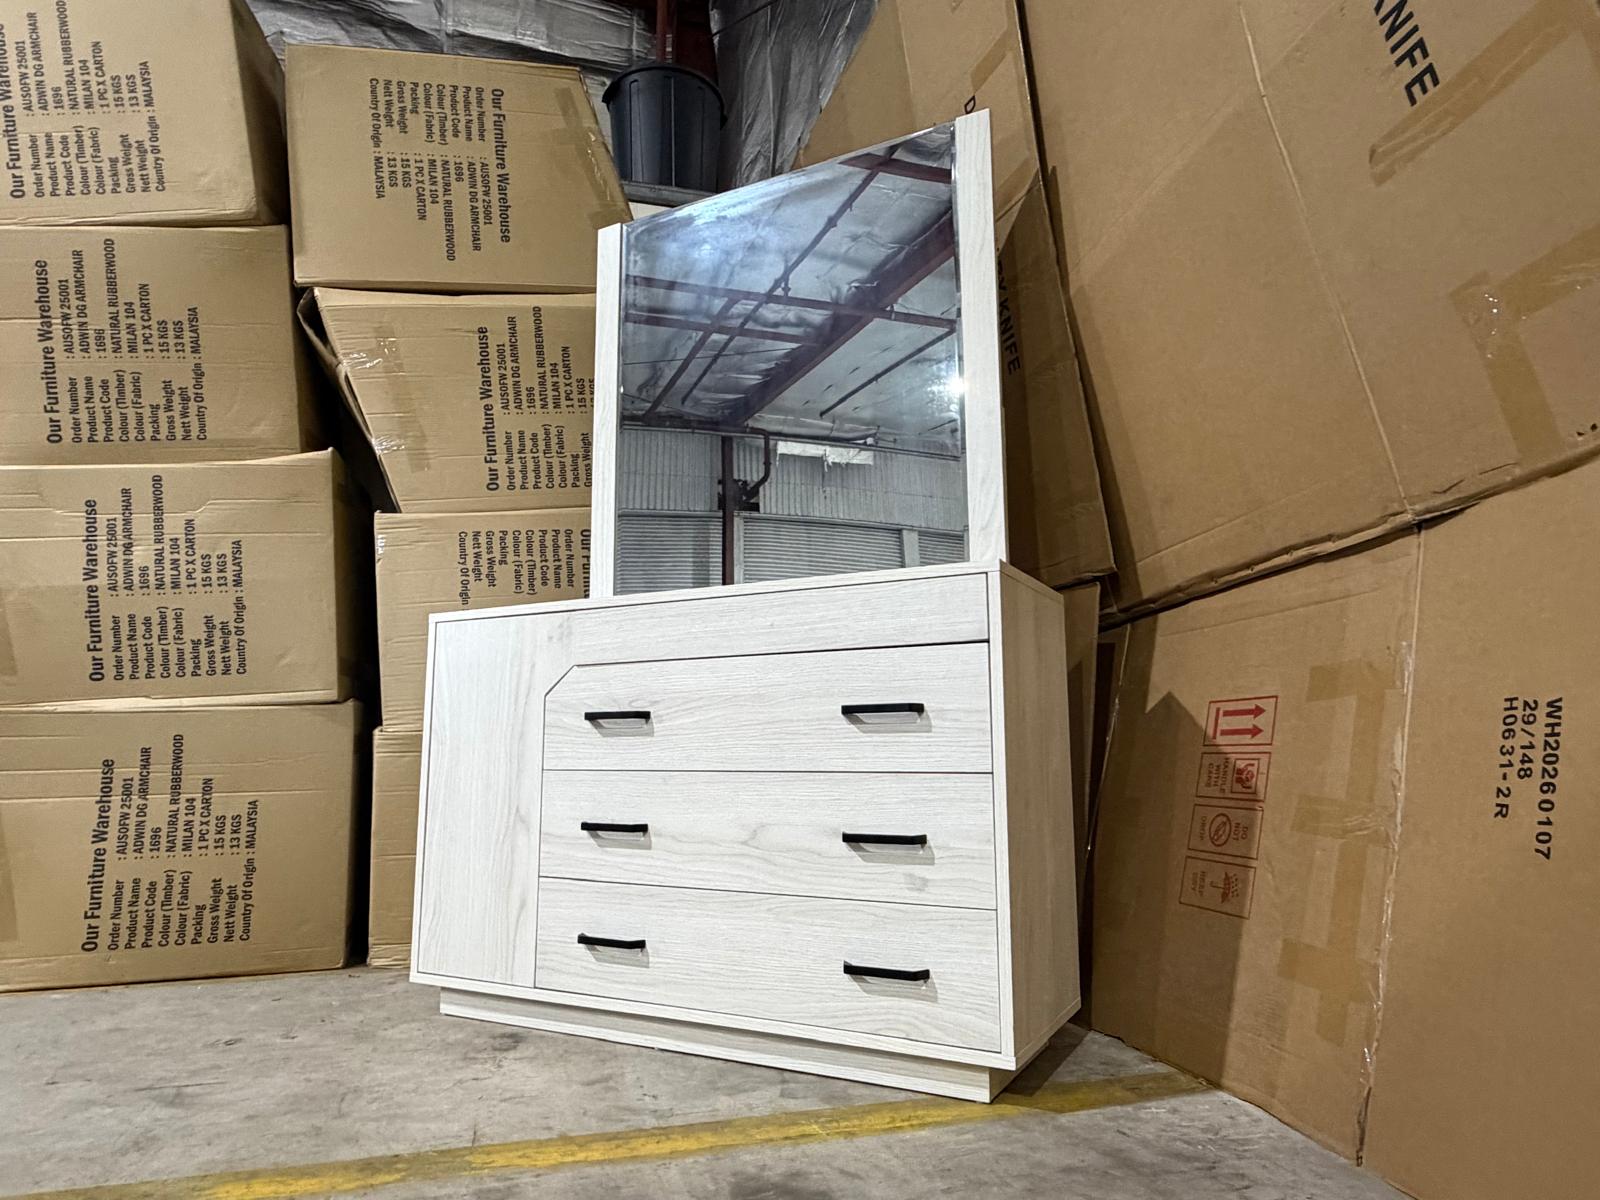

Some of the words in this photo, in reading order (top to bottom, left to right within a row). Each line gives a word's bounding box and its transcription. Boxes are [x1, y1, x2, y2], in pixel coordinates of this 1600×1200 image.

[1374, 0, 1440, 107] NIFE
[491, 89, 504, 111] Our
[2, 105, 22, 170] Furniture
[493, 113, 507, 170] Furniture
[10, 174, 26, 199] Our
[497, 173, 512, 243] Warehouse
[104, 239, 119, 308] RUBBERWOOD
[34, 260, 54, 342] Warehouse
[58, 279, 71, 310] 25001
[60, 312, 74, 354] AUSOFW
[108, 309, 122, 353] NATURAL
[157, 320, 168, 339] KGS
[187, 307, 201, 354] MALAYSIA
[507, 316, 520, 364] ARMCHAIR
[532, 306, 546, 368] RUBBERWOOD
[999, 297, 1021, 375] KNIFE
[159, 341, 170, 353] 15
[477, 327, 493, 400] Warehouse
[496, 343, 507, 371] 25001
[561, 346, 572, 380] CARTON
[40, 346, 60, 413] Furniture
[192, 363, 205, 390] Origin
[511, 366, 521, 378] DG
[67, 377, 80, 415] Number
[113, 369, 129, 410] (Timber)
[161, 380, 175, 413] Weight
[193, 392, 204, 403] Of
[498, 373, 510, 410] AUSOFW
[512, 380, 523, 410] ADWIN
[537, 370, 549, 409] NATURAL
[564, 389, 574, 401] PC
[46, 418, 63, 444] Our
[71, 417, 83, 443] Order
[118, 411, 130, 442] Colour
[165, 415, 177, 441] Gross
[195, 405, 208, 441] Country
[482, 404, 498, 464] Furniture
[503, 431, 514, 464] Number
[517, 430, 527, 454] Name
[541, 424, 554, 459] (Timber)
[486, 467, 499, 491] Our
[506, 466, 516, 491] Order
[518, 456, 529, 490] Product
[545, 460, 555, 489] Colour
[570, 453, 581, 488] Packing
[121, 488, 133, 540] ARMCHAIR
[82, 499, 99, 581] Warehouse
[106, 517, 118, 548] 25001
[122, 542, 134, 556] DG
[169, 537, 180, 555] 104
[184, 519, 196, 557] CARTON
[457, 531, 469, 565] Country
[472, 531, 482, 550] Nett
[485, 530, 495, 555] Gross
[498, 530, 509, 566] Packing
[512, 530, 522, 558] Colour
[525, 530, 535, 557] Colour
[538, 529, 549, 563] Product
[551, 529, 562, 563] Product
[564, 529, 574, 552] Order
[107, 550, 119, 592] AUSOFW
[123, 558, 134, 591] ADWIN
[170, 558, 181, 590] MILAN
[185, 568, 197, 580] PC
[460, 567, 470, 577] Of
[471, 551, 483, 582] Weight
[485, 556, 497, 587] Weight
[512, 560, 524, 594] (Fabric)
[525, 559, 538, 595] (Timber)
[540, 565, 550, 587] Code
[553, 564, 562, 589] Name
[566, 554, 575, 588] Number
[459, 579, 471, 605] Origin
[84, 585, 103, 652] Furniture
[110, 615, 122, 653] Number
[126, 614, 137, 641] Name
[172, 608, 187, 645] (Fabric)
[89, 656, 105, 682] Our
[112, 655, 125, 681] Order
[127, 643, 140, 680] Product
[175, 647, 186, 678] Colour
[189, 639, 202, 677] Packing
[1517, 699, 1539, 780] 29/148
[169, 734, 184, 805] RUBBERWOOD
[1493, 697, 1519, 819] H0631-2R
[1534, 697, 1563, 861] WH20260107
[91, 759, 115, 844] Warehouse
[184, 797, 196, 817] 104
[149, 827, 162, 852] 1696
[165, 807, 180, 852] NATURAL
[181, 820, 194, 852] MILAN
[214, 815, 226, 835] KGS
[213, 837, 225, 849] 15
[84, 848, 107, 920] Furniture
[144, 881, 157, 907] Code
[160, 869, 177, 912] (Timber)
[177, 871, 193, 911] (Fabric)
[209, 878, 224, 914] Weight
[81, 924, 100, 952] Our
[141, 908, 155, 948] Product
[158, 914, 171, 947] Colour
[174, 913, 187, 946] Colour
[207, 915, 220, 944] Gross
